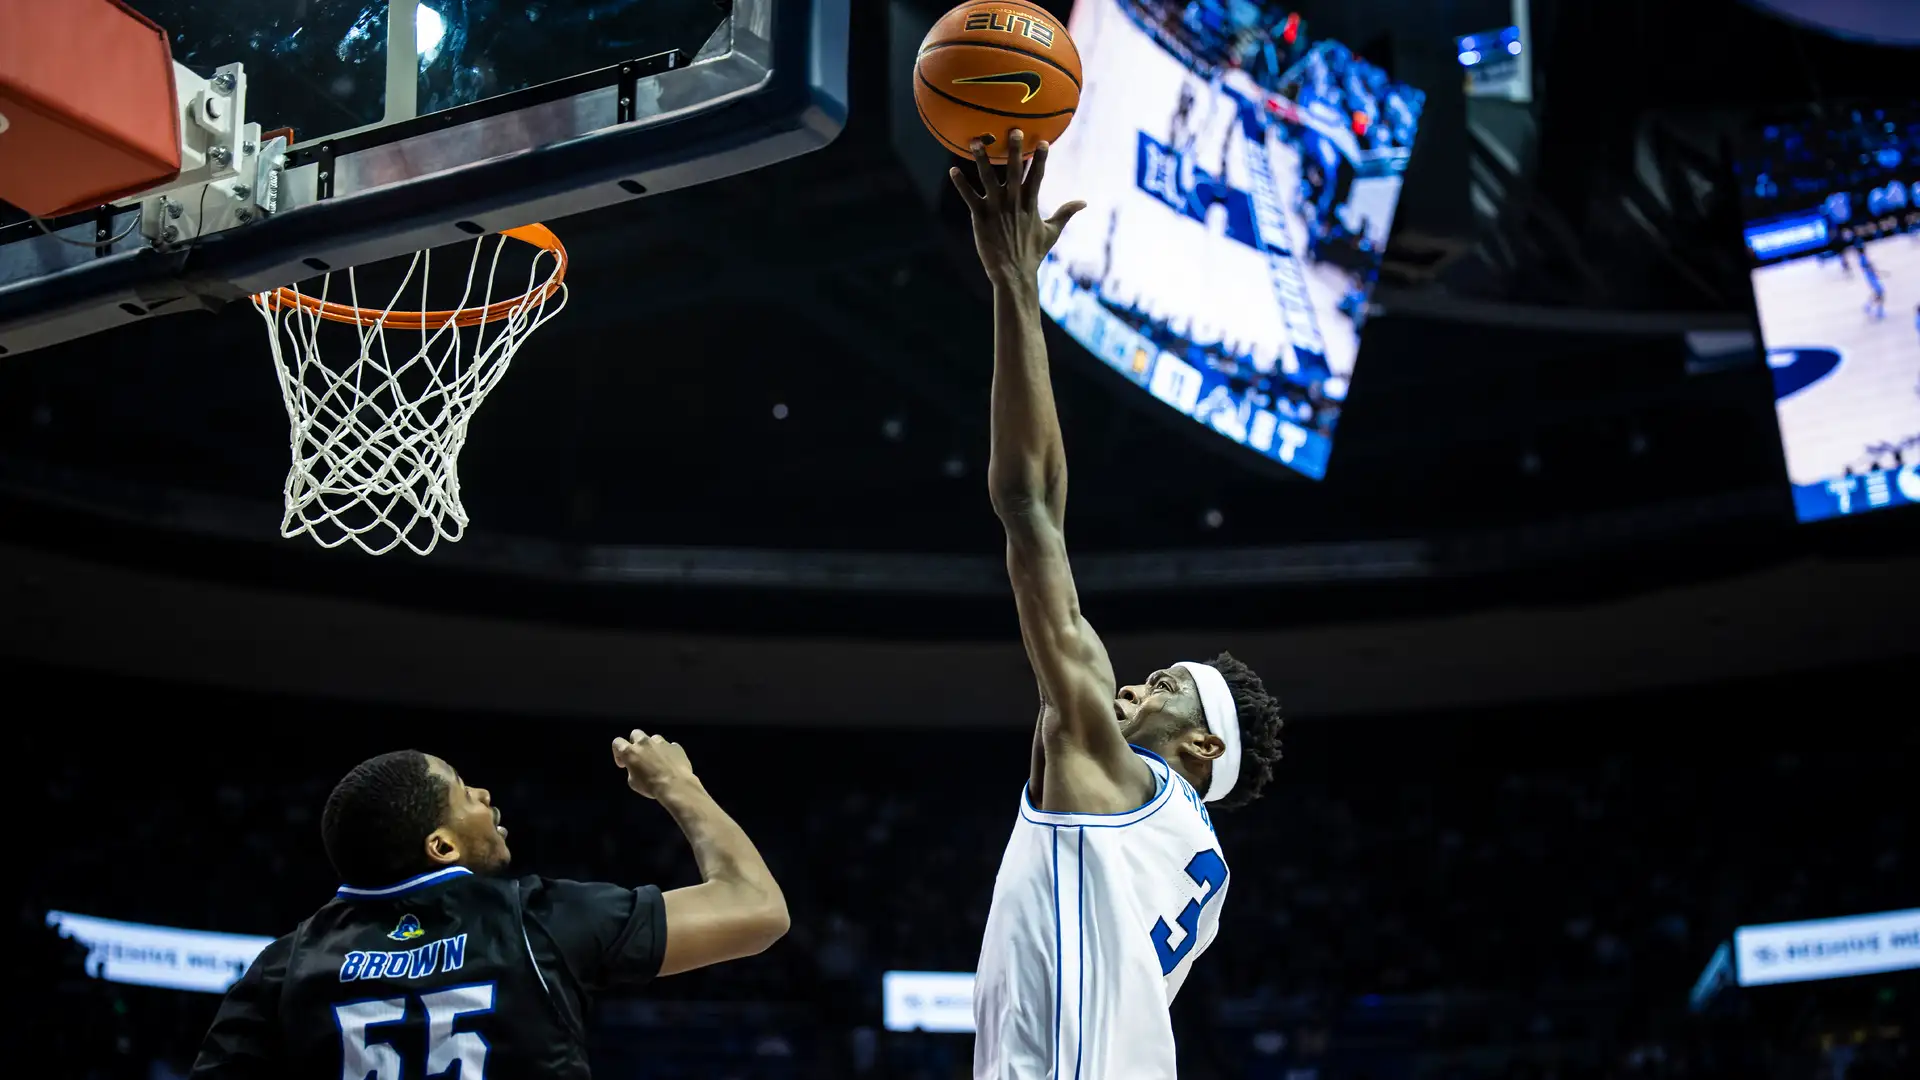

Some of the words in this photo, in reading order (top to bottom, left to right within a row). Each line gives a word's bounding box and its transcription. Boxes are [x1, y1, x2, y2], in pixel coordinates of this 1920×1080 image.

[964, 12, 1054, 49] ELITE
[1149, 848, 1228, 977] 3
[339, 933, 468, 983] BROWN
[330, 979, 497, 1080] 55
